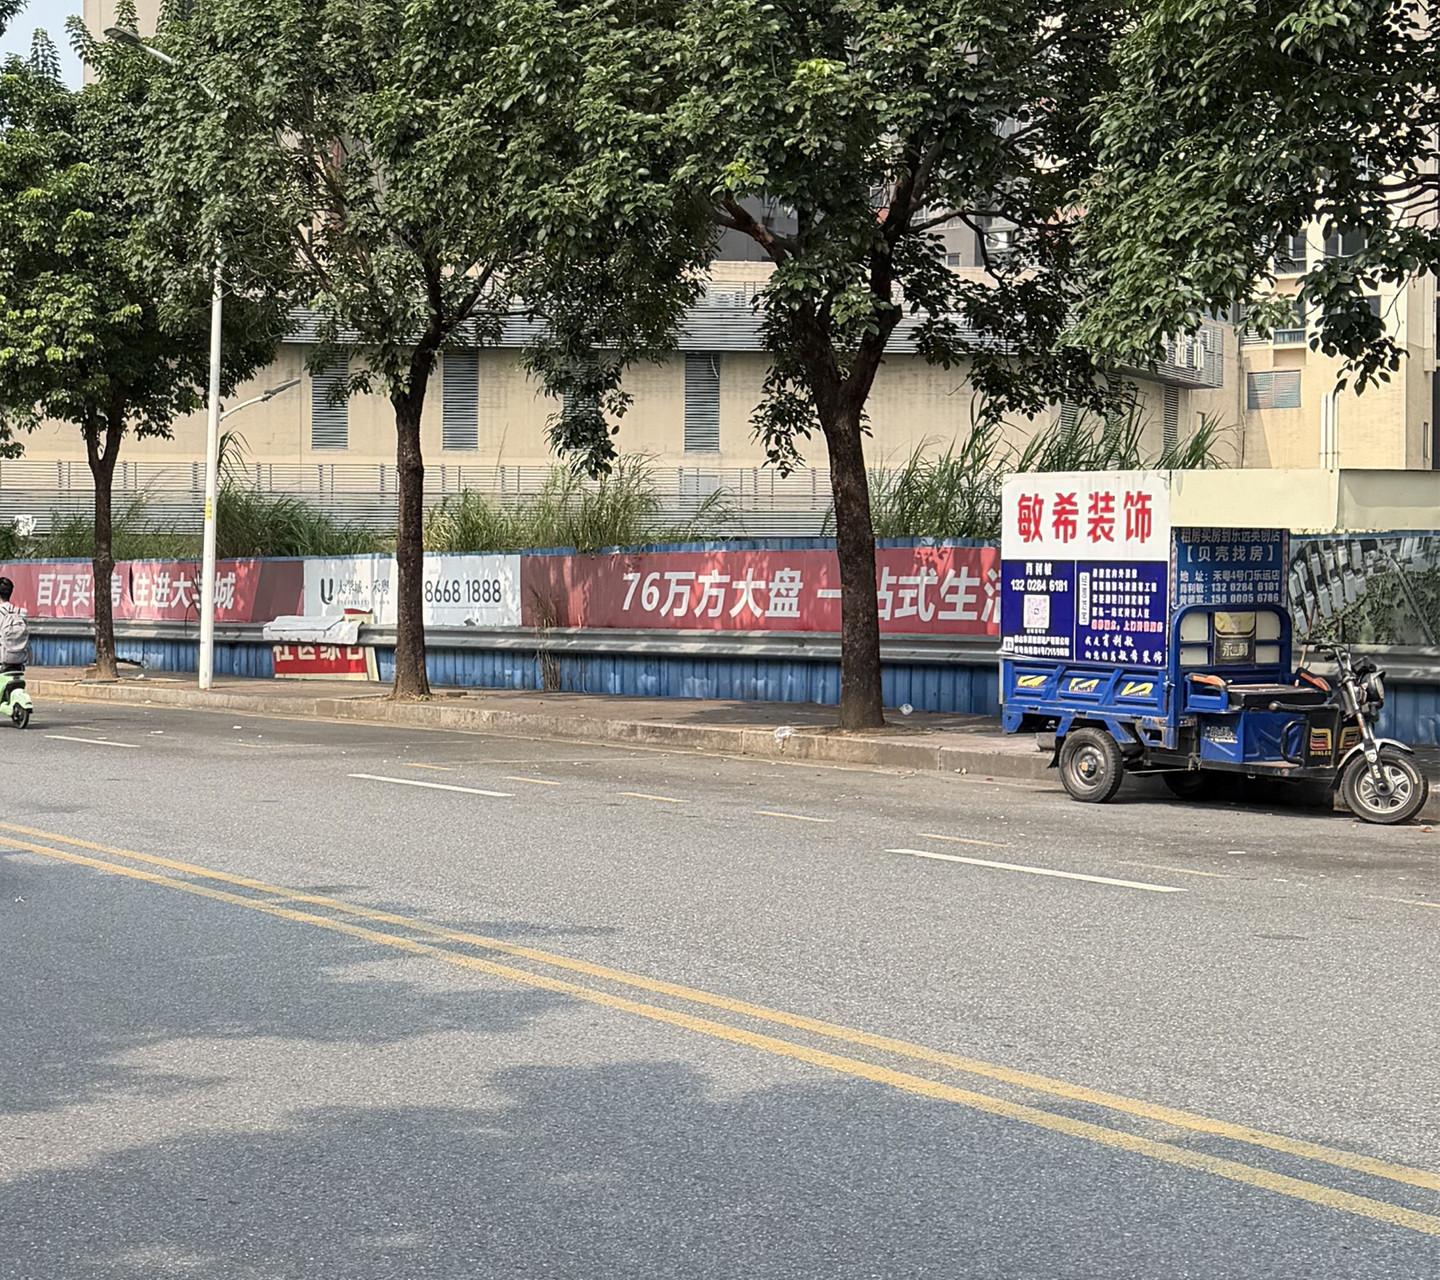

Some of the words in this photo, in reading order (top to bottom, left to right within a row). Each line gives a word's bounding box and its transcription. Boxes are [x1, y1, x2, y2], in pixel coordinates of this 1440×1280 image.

[1017, 491, 1152, 543] 敏希装饰
[37, 572, 122, 607] 百万买房
[424, 579, 461, 603] 8668
[465, 579, 502, 603] 1888
[622, 567, 804, 618] 76万方大盘
[1010, 579, 1025, 591] 132
[1027, 579, 1047, 591] 0284
[1049, 580, 1068, 592] 6181
[1211, 582, 1227, 592] 132
